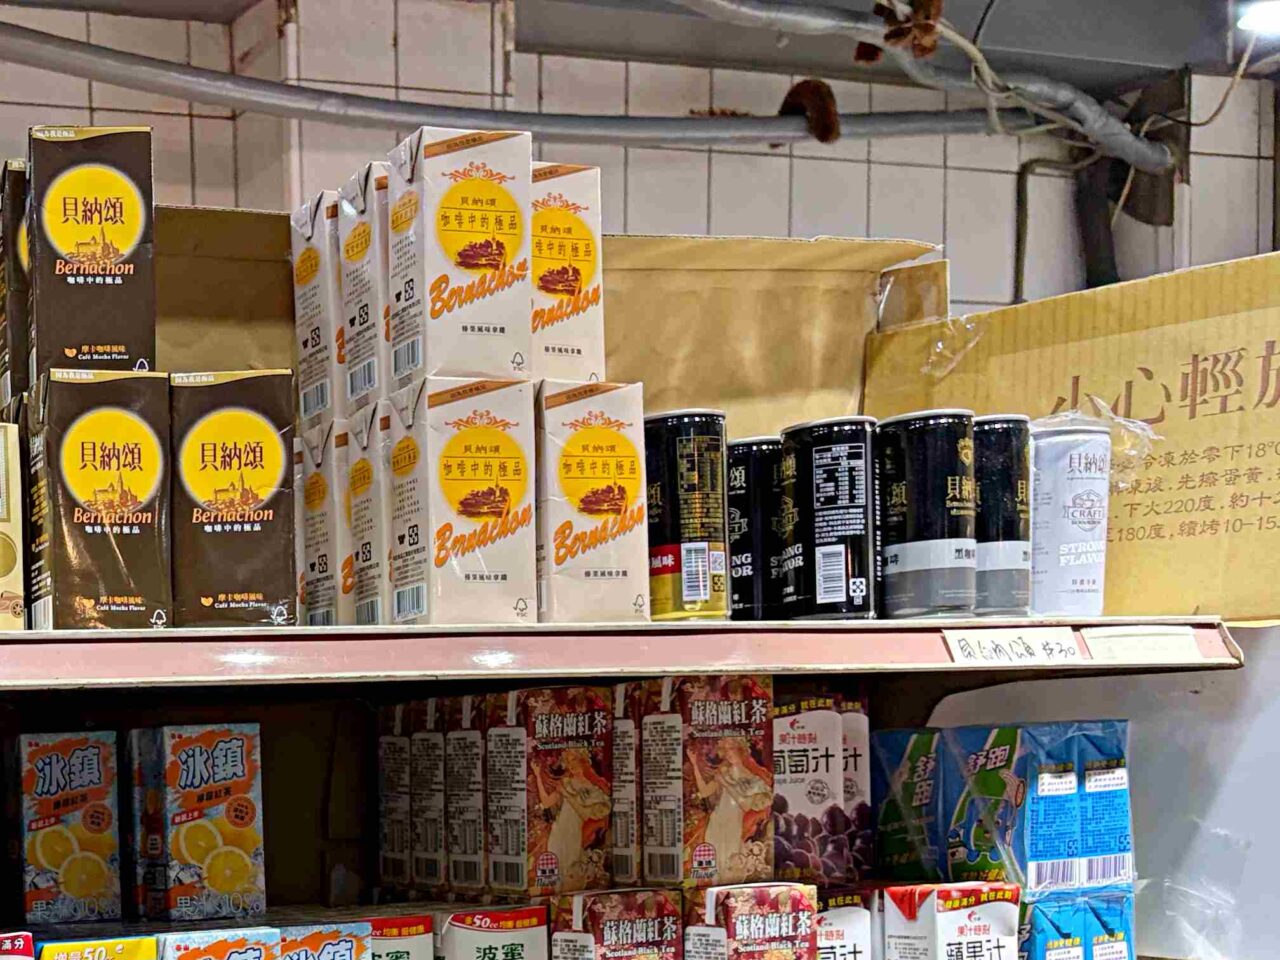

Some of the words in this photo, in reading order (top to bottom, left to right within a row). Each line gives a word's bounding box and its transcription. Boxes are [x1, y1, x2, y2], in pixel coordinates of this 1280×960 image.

[62, 195, 126, 225] 貝納頌
[441, 211, 517, 231] 咖啡中的極品
[55, 260, 134, 276] Bernachon
[429, 258, 527, 320] Bernachon
[79, 440, 143, 471] 貝納頌
[200, 440, 265, 471] 貝納頌
[444, 460, 521, 477] 咖啡中的極品
[563, 459, 636, 476] 咖啡中的極品
[73, 508, 152, 524] Bernachon
[192, 509, 273, 524] Bernachon
[1071, 510, 1102, 518] CRAFT
[535, 711, 607, 738] 蘇格蘭紅茶
[603, 916, 677, 945] 蘇格蘭紅茶
[735, 912, 812, 940] 蘇格蘭紅茶
